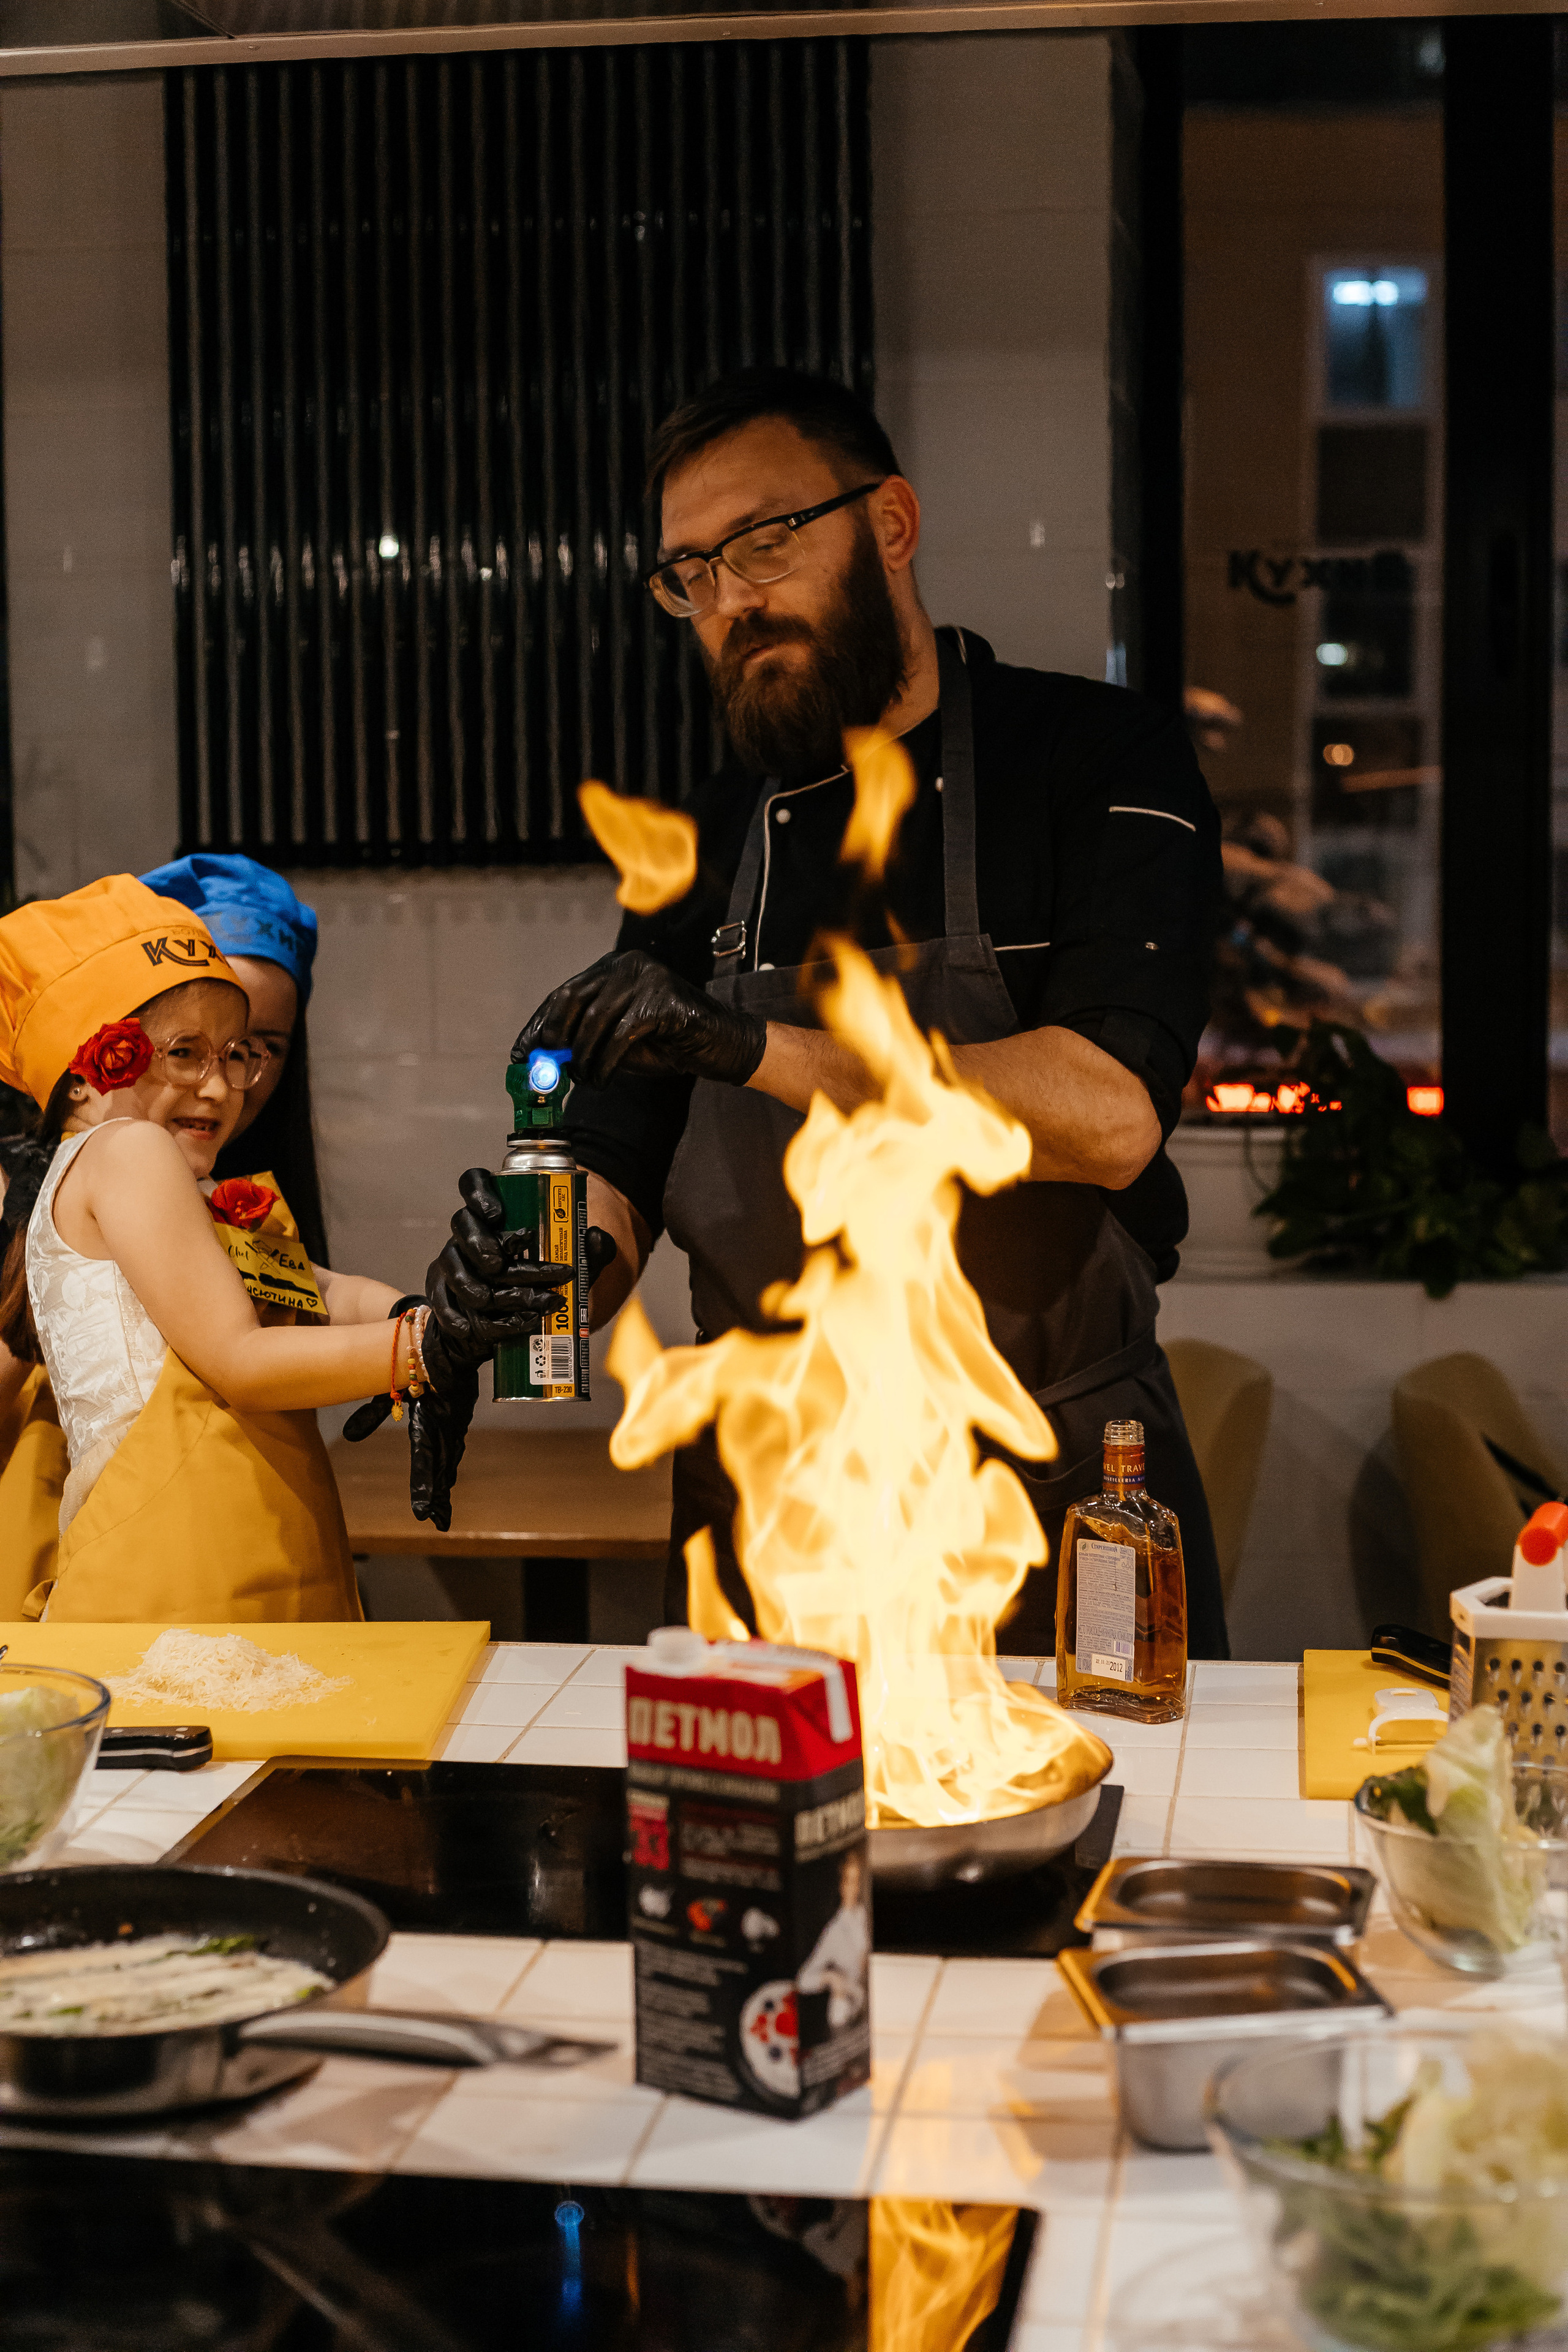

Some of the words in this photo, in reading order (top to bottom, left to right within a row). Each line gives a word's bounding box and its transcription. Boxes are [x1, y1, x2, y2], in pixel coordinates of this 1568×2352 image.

[141, 937, 232, 969] КУХ
[1109, 1661, 1123, 1673] 2012
[629, 1696, 783, 1765] ПЕТМОЛ
